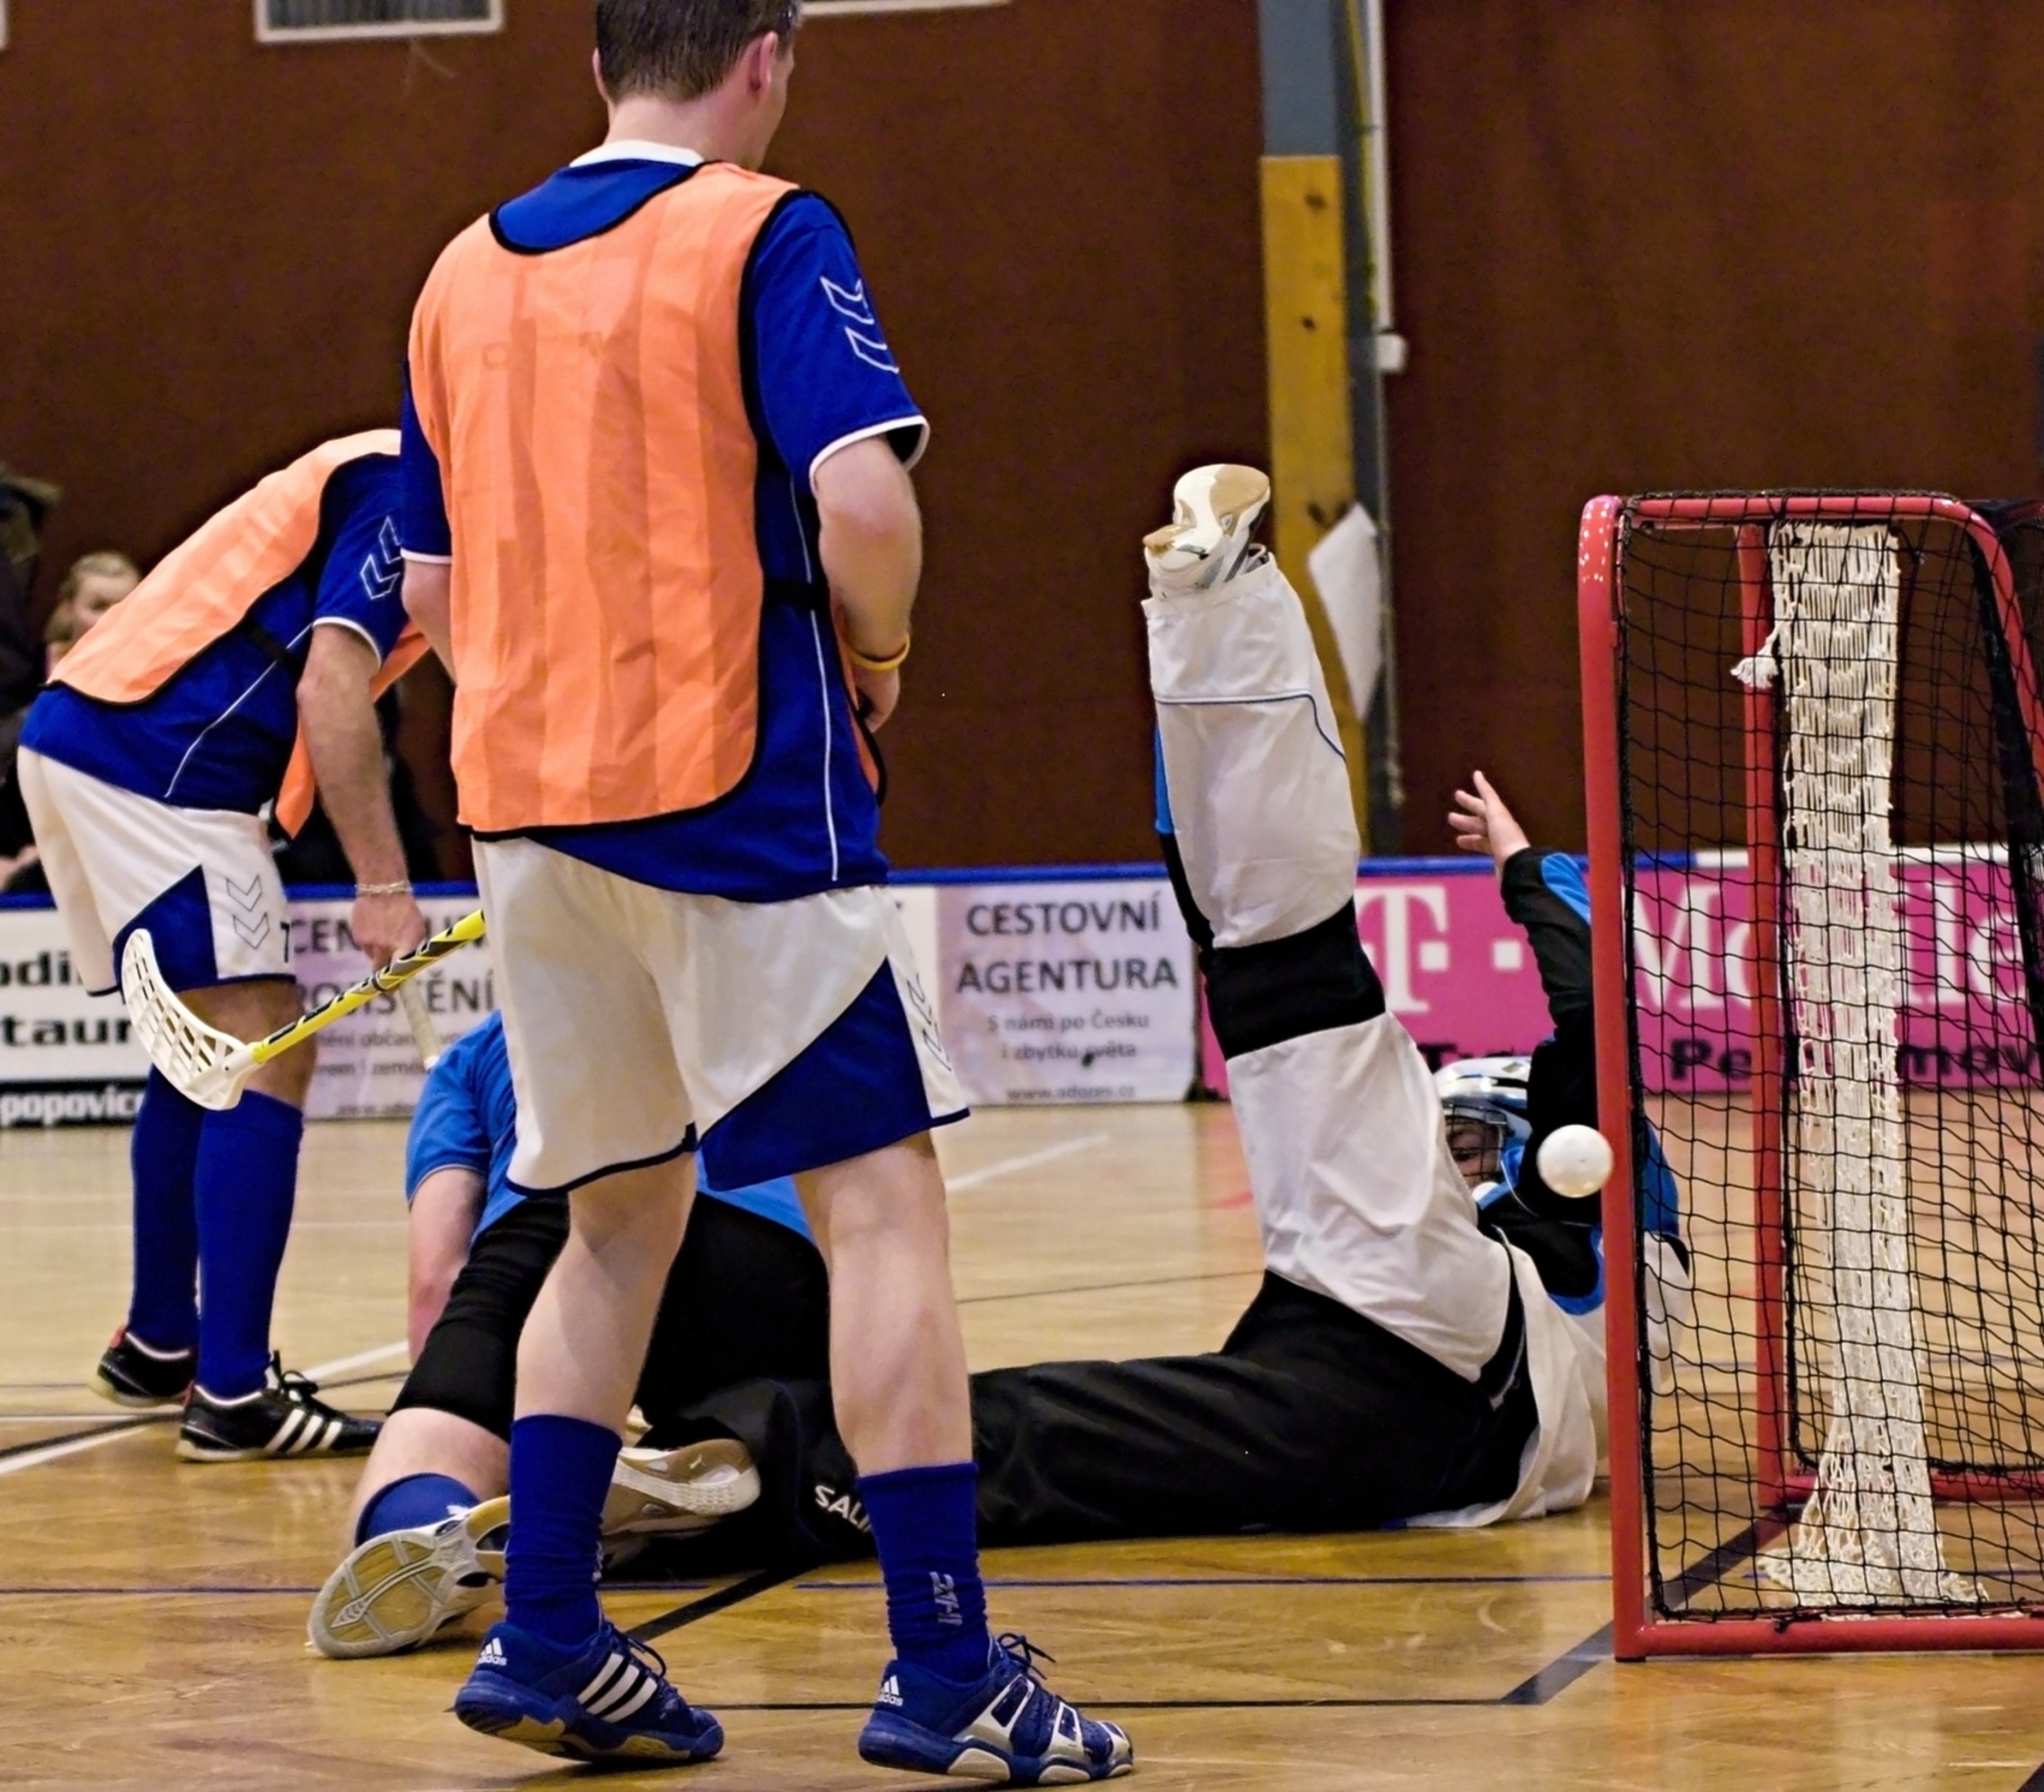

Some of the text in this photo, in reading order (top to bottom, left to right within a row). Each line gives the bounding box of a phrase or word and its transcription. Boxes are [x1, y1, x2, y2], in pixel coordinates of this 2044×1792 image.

[966, 891, 1161, 936] CESTOVNÍ
[1354, 884, 1447, 1014] T
[1622, 880, 2025, 1010] Mile
[956, 958, 1178, 994] AGENTURA
[1060, 1016, 1086, 1034] po
[1090, 1007, 1151, 1030] Česku
[0, 1084, 144, 1125] popovic
